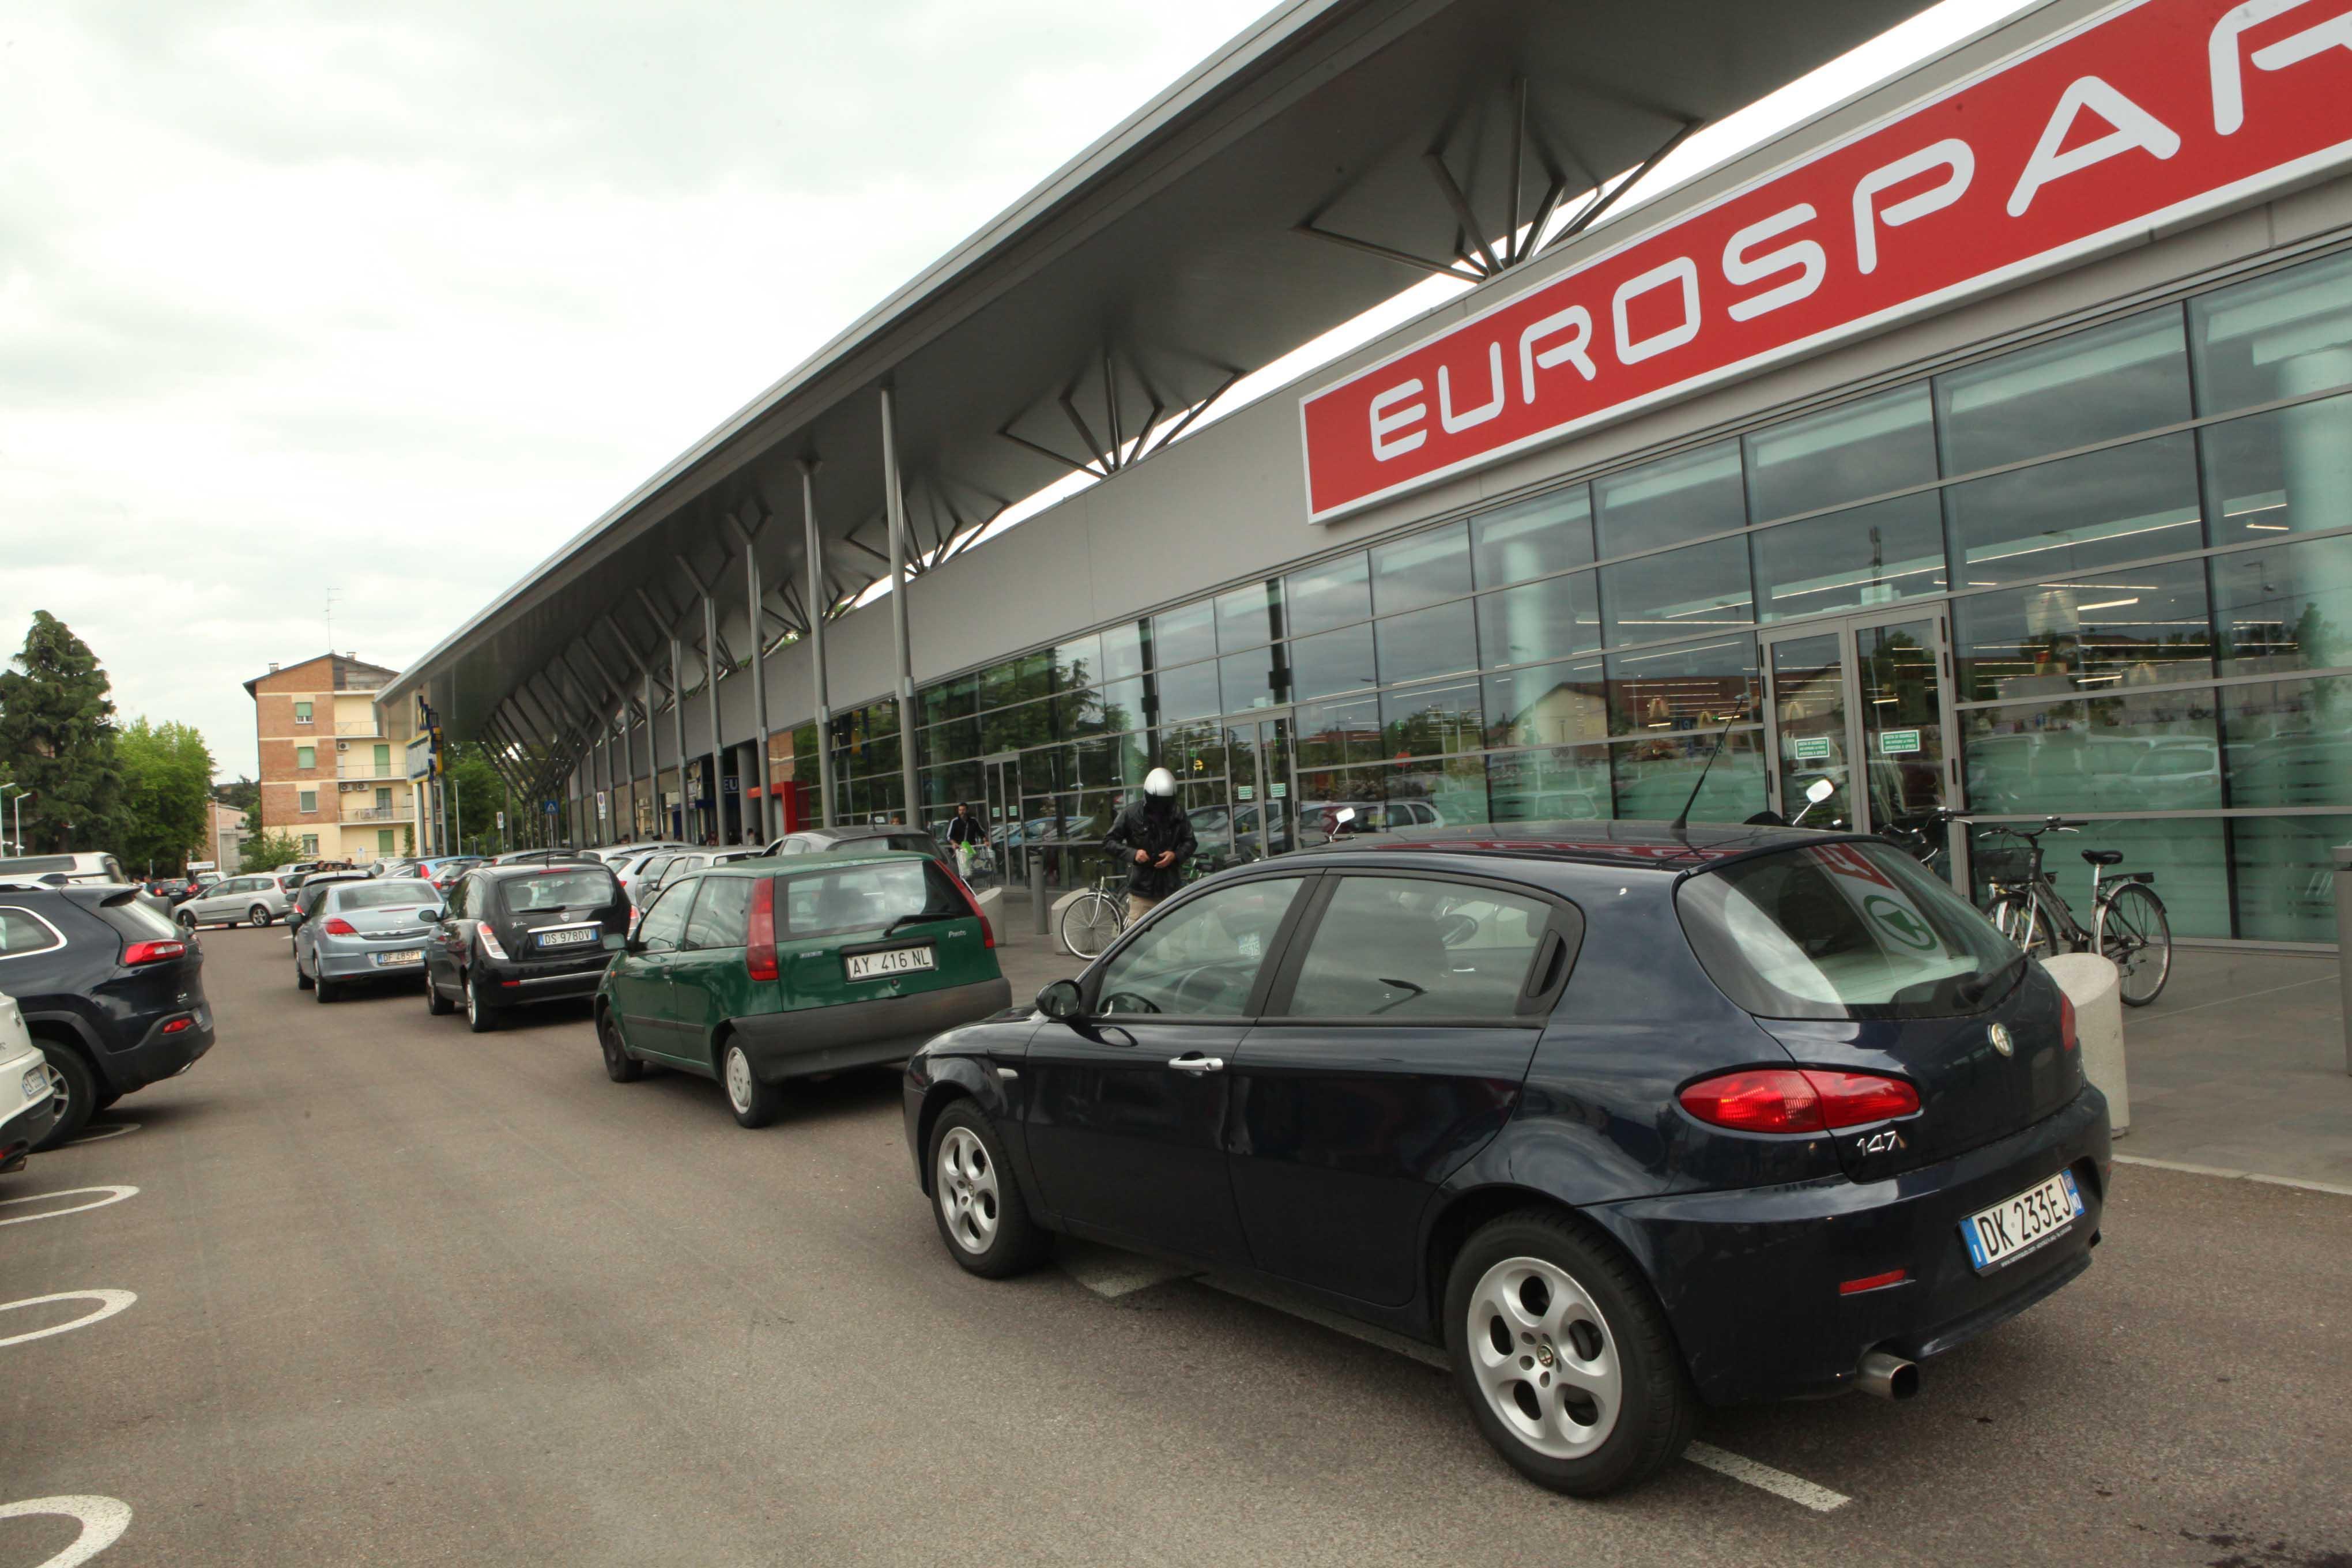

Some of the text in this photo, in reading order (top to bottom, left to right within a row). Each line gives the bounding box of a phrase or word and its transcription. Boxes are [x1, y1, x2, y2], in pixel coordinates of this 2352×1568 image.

[545, 930, 591, 944] DS 978DV
[853, 948, 930, 975] AY 416 NL
[1856, 1130, 1896, 1156] 147
[1977, 1208, 2015, 1257] DK
[2014, 1178, 2071, 1241] 233EJ
